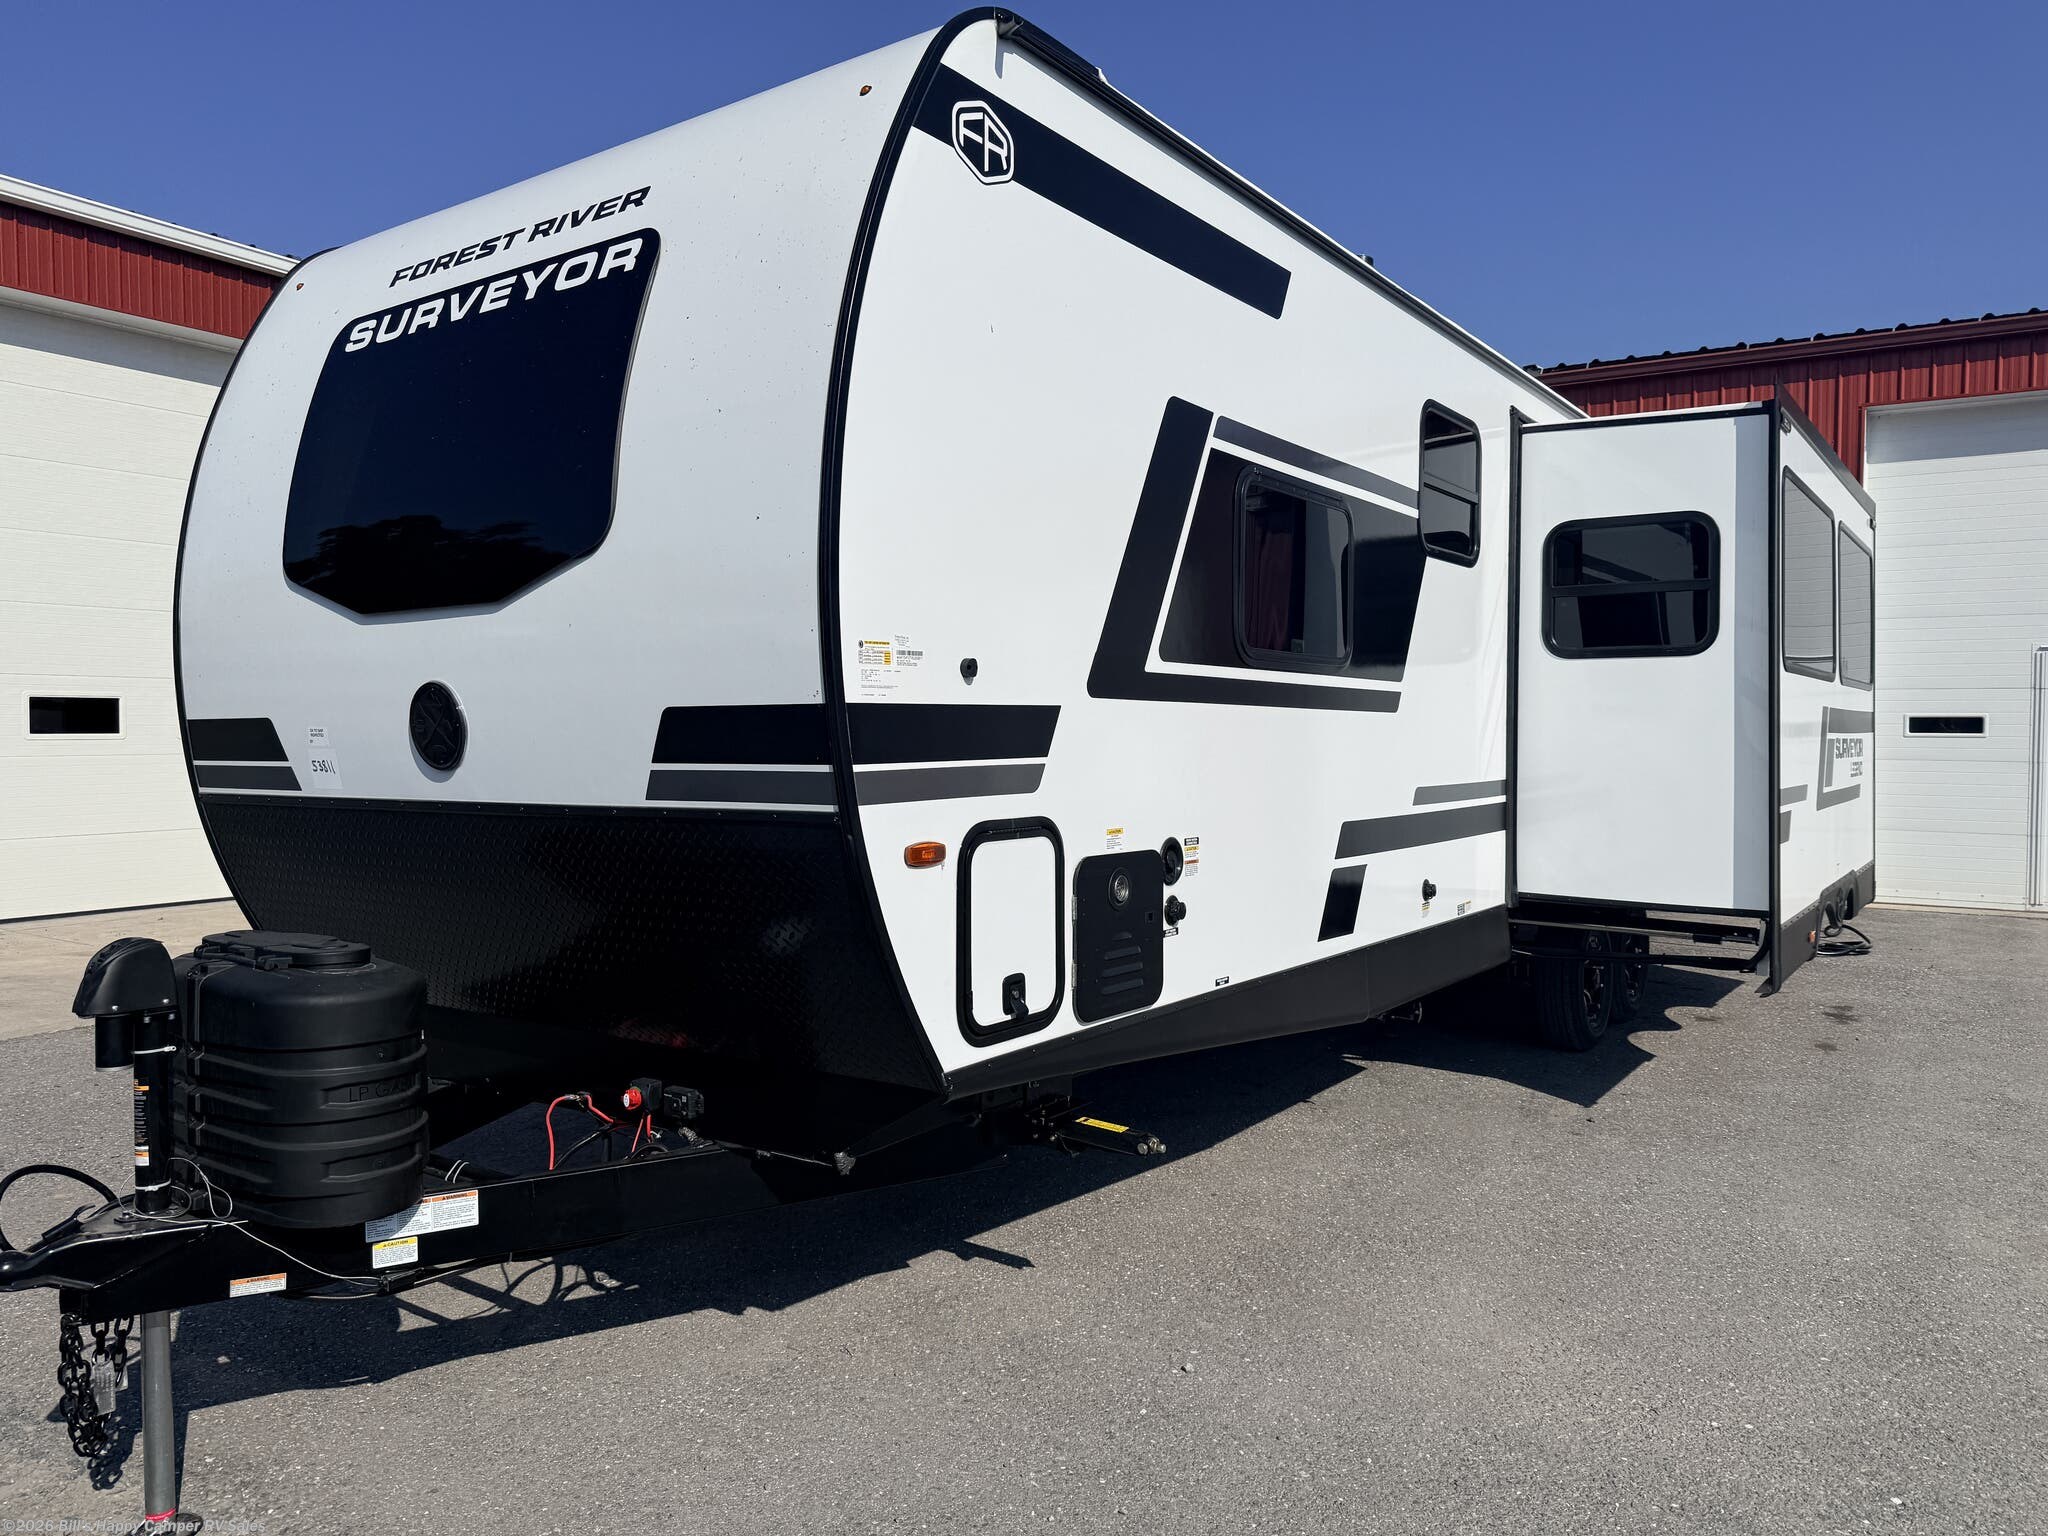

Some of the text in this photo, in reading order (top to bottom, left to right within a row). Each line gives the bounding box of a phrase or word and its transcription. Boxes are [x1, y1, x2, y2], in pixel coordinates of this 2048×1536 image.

[958, 112, 1008, 172] FR
[388, 185, 652, 288] FOREST RIVER
[344, 237, 644, 354] SURVEYOR
[1835, 737, 1864, 759] SURVEYOR
[349, 1086, 369, 1102] LP
[387, 1239, 409, 1247] CAUTION
